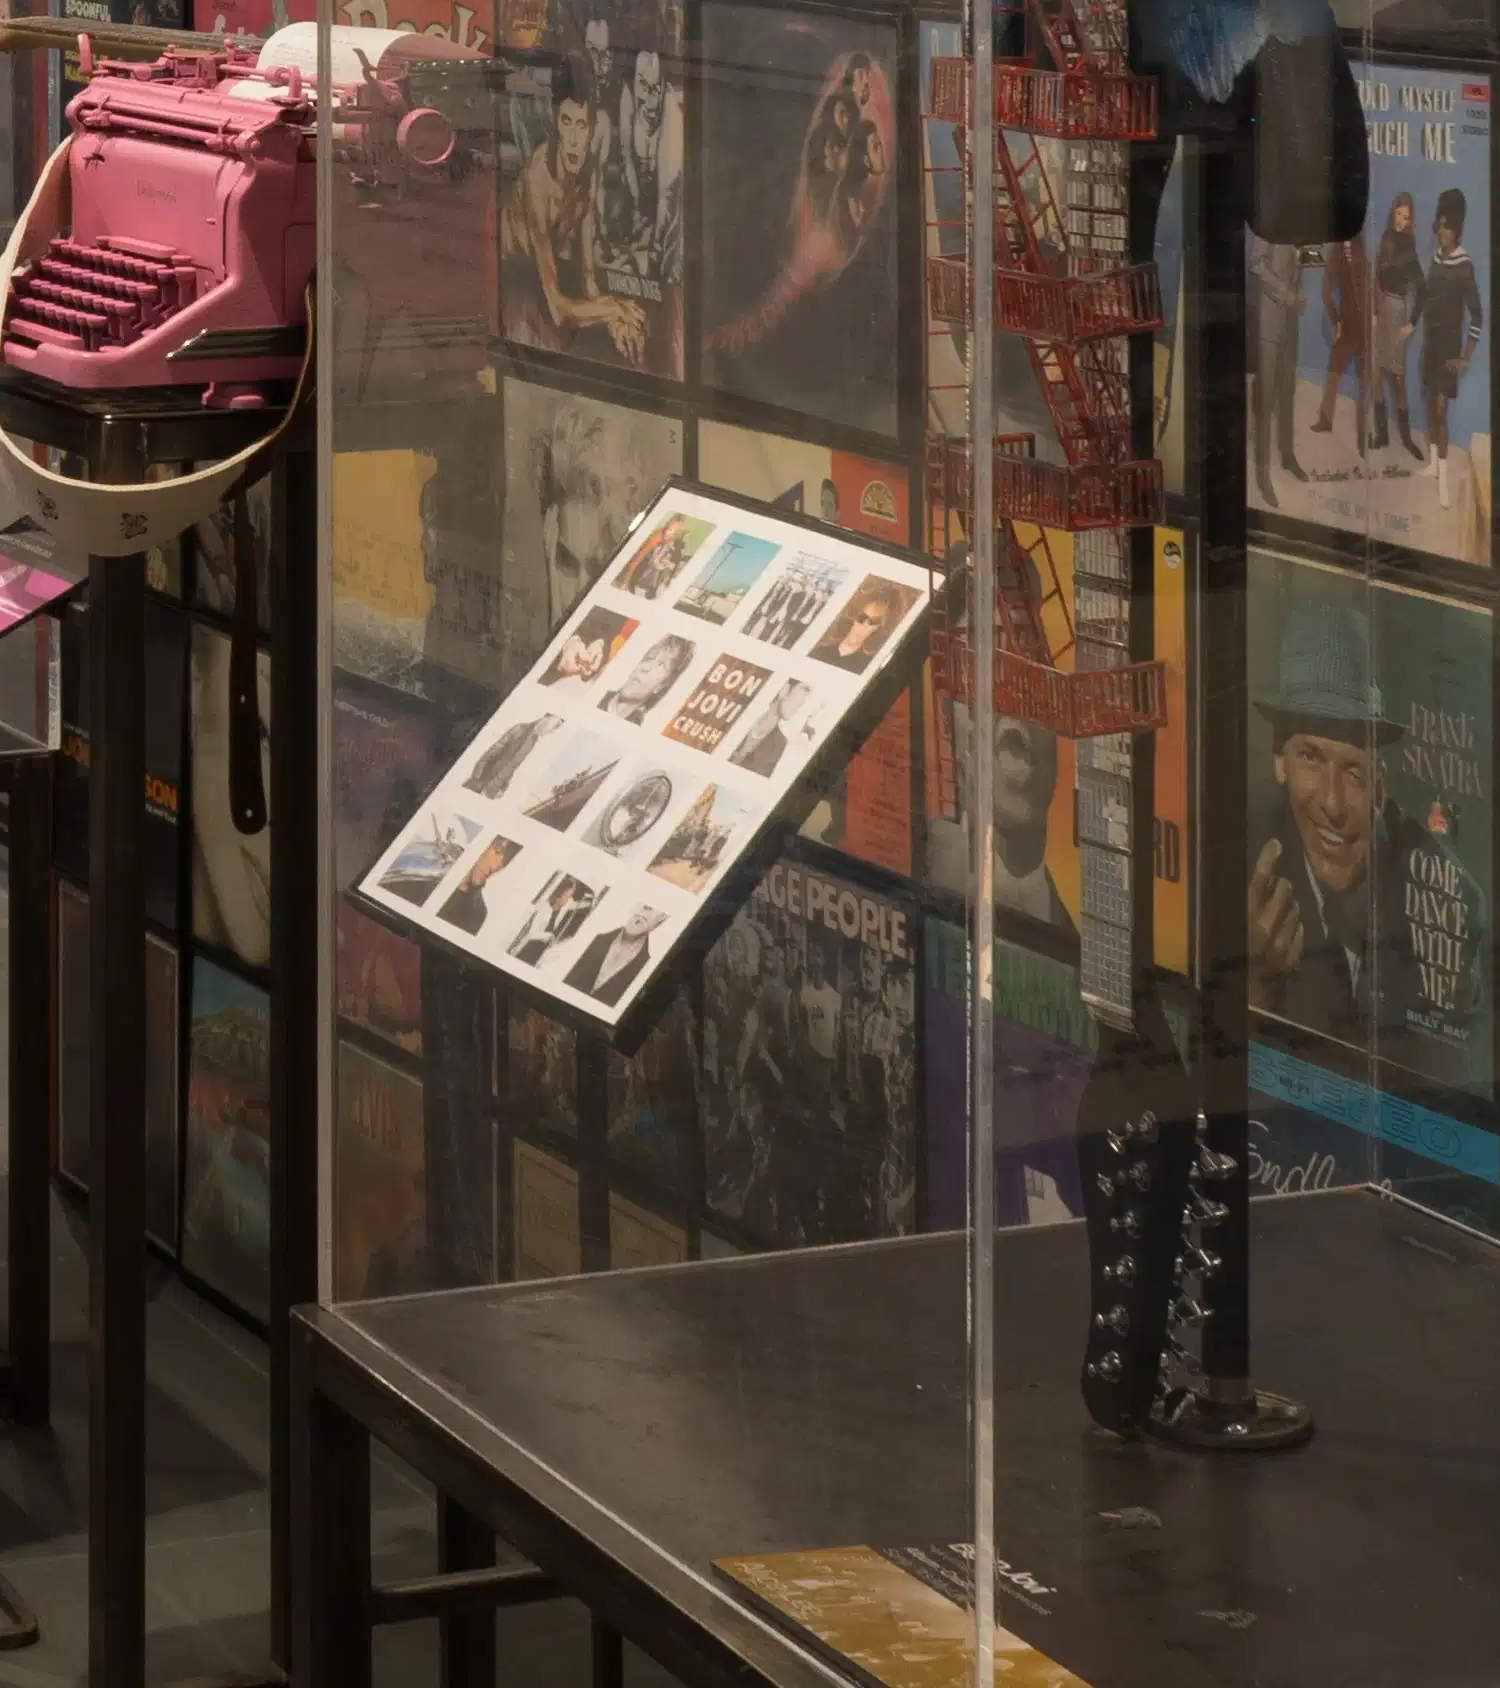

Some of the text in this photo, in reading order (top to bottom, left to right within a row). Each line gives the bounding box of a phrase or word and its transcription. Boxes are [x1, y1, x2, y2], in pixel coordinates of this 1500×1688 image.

[1402, 85, 1456, 113] MYSELF
[1423, 122, 1457, 163] ME
[707, 655, 765, 696] BON
[689, 687, 741, 724] JOVI
[1410, 700, 1476, 749] FRANK
[673, 717, 723, 746] CRUSH
[1410, 847, 1463, 900] COME
[805, 874, 907, 954] PEOPLE
[1404, 881, 1469, 940] DANCE
[1410, 924, 1464, 974] WITH
[1418, 962, 1457, 1010] ME!
